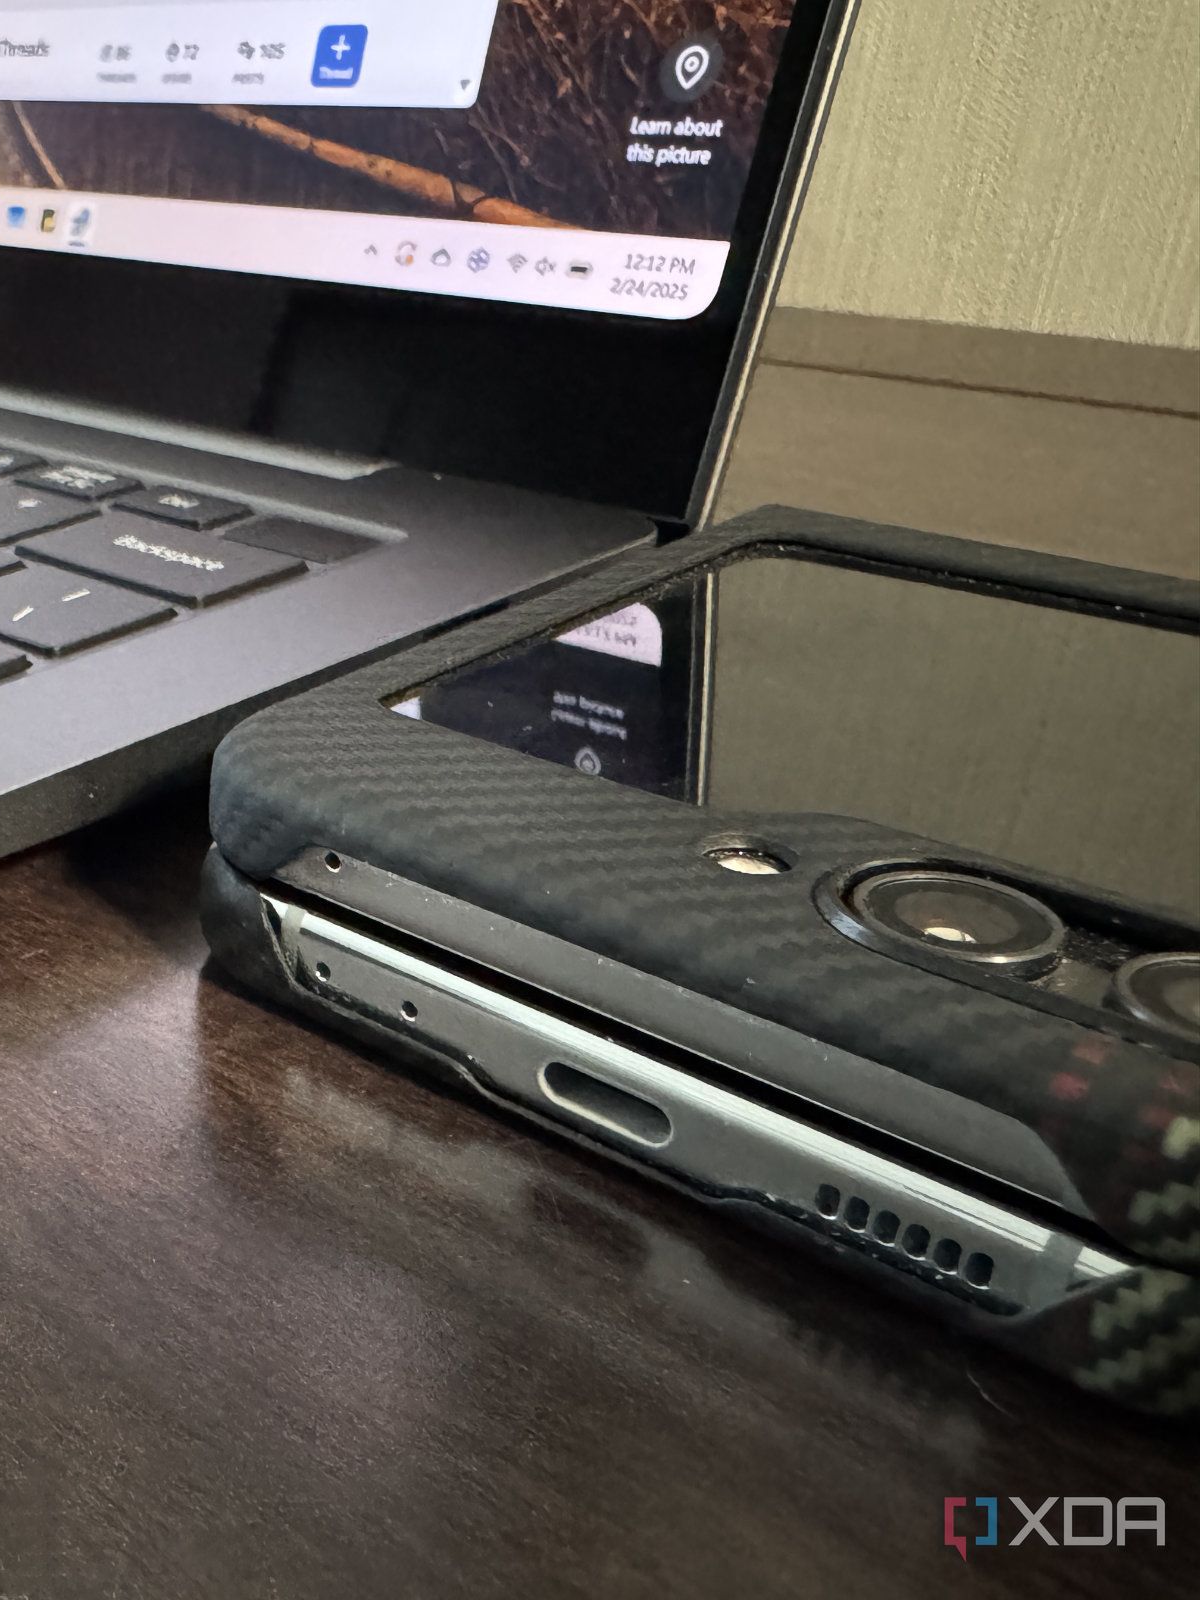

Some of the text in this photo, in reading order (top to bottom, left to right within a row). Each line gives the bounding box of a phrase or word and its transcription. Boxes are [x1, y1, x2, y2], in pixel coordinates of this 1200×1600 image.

[629, 116, 724, 137] Learn about
[626, 142, 712, 168] this picture
[669, 256, 696, 275] PM
[609, 277, 689, 301] 2/24/2025
